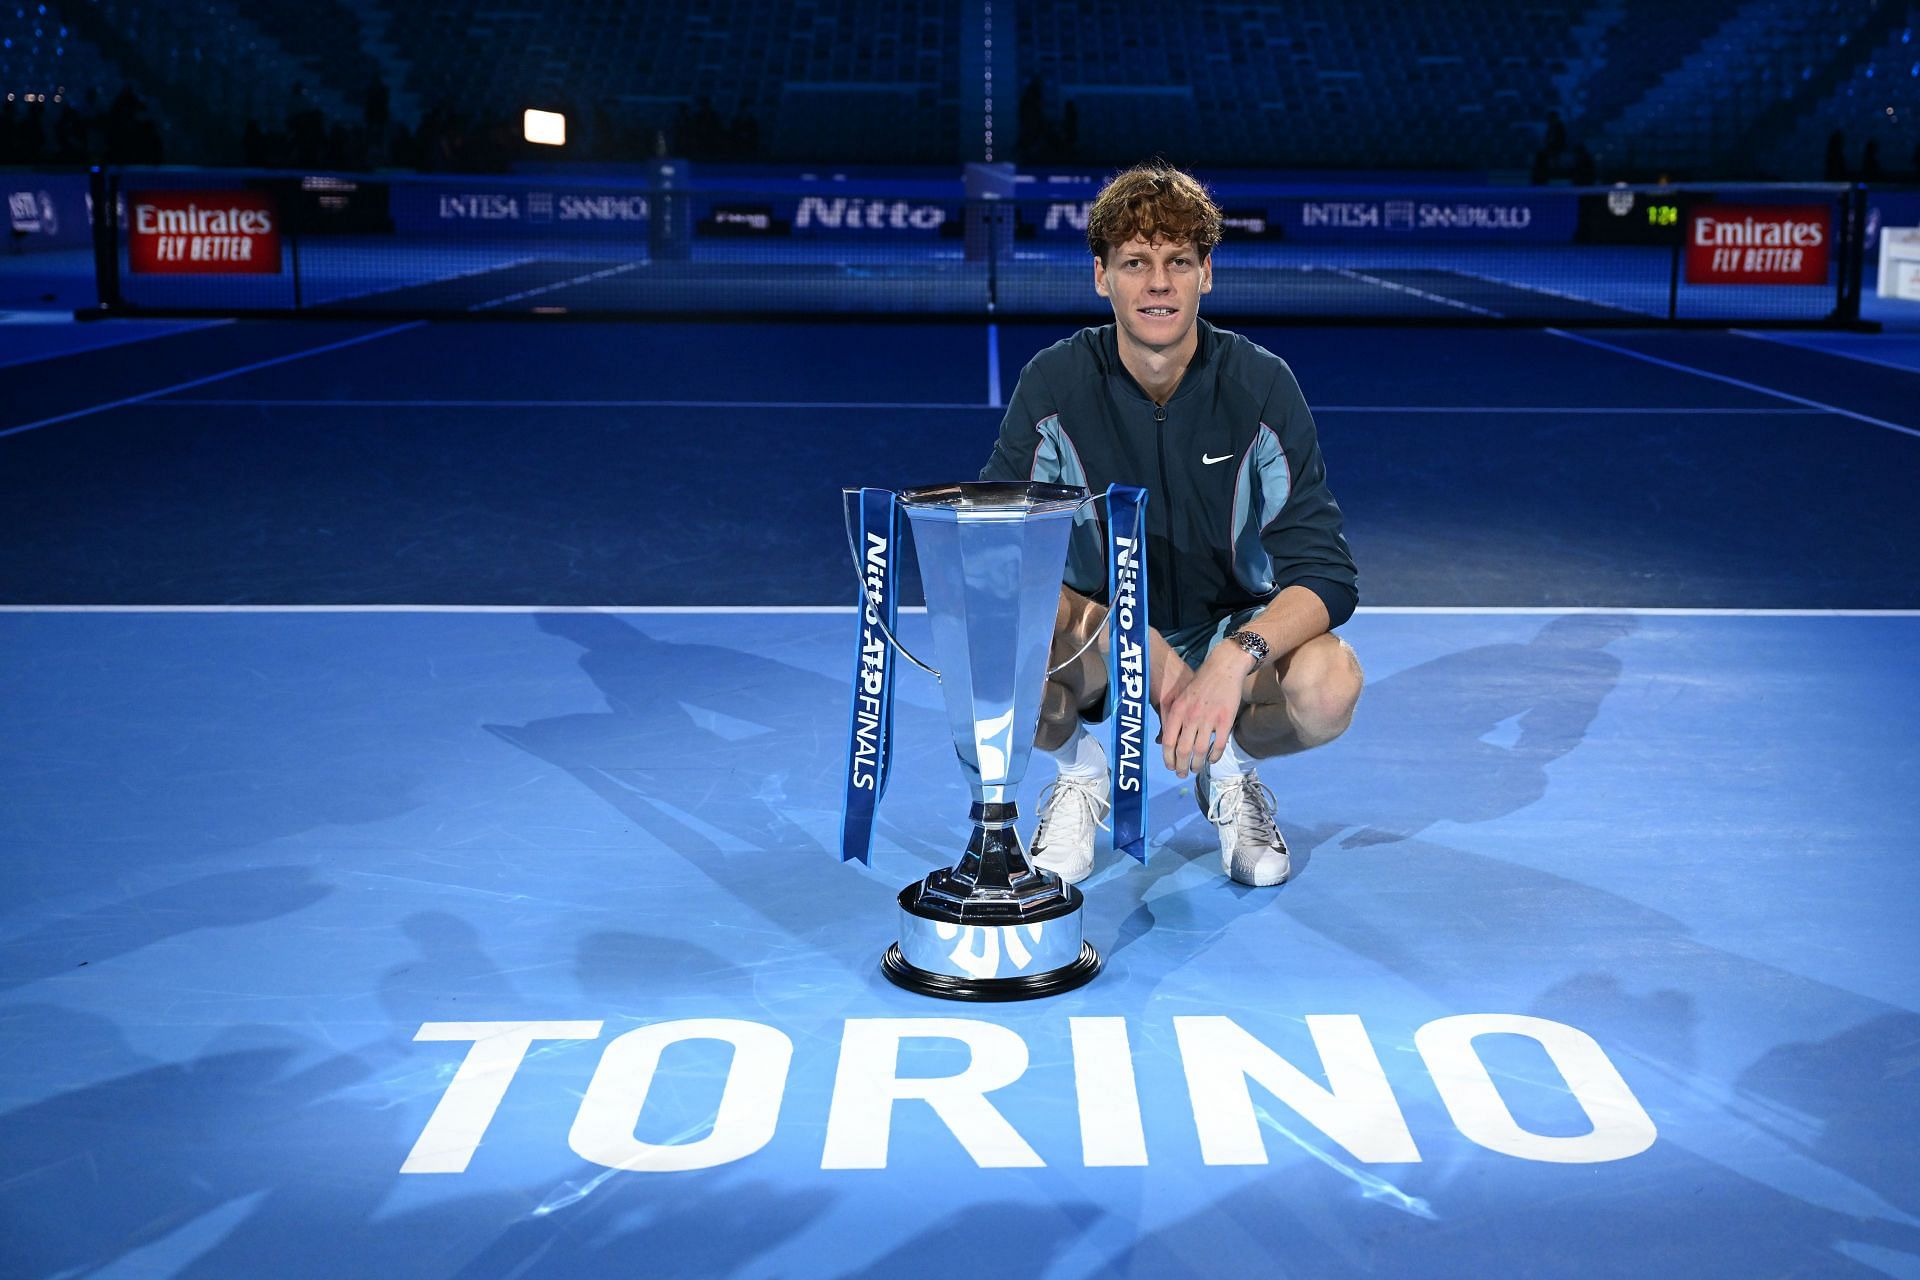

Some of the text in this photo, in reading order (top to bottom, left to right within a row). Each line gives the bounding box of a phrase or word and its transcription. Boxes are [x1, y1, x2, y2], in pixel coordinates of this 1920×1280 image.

[135, 204, 272, 235] Emirates
[439, 194, 650, 220] INTESA SANPAO
[796, 197, 947, 229] Nitto
[1302, 202, 1379, 227] INTESA
[1694, 217, 1823, 247] Emirates
[156, 236, 253, 262] FLY BETTER
[1712, 247, 1803, 272] FLY BETTER
[852, 532, 887, 789] Nitto ATP FINALS
[1116, 536, 1142, 791] Nitto ATP FINALS
[400, 1013, 1658, 1174] TORINO
